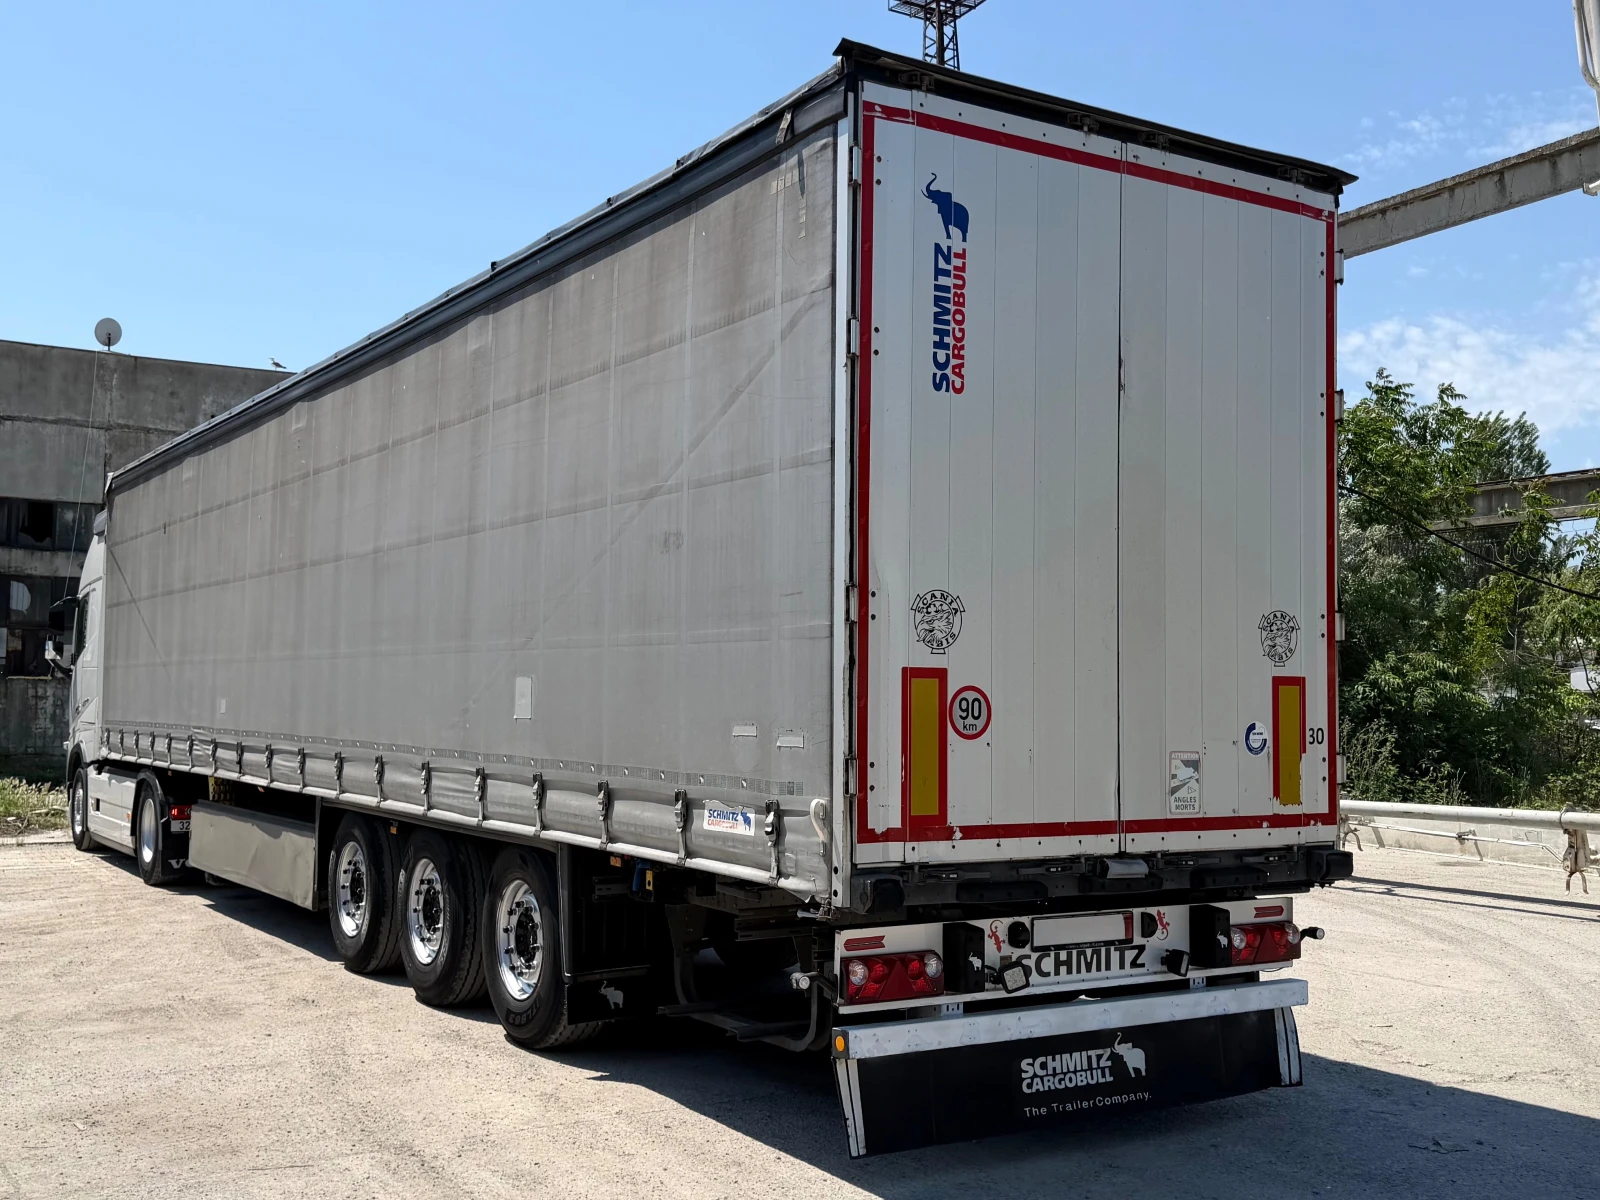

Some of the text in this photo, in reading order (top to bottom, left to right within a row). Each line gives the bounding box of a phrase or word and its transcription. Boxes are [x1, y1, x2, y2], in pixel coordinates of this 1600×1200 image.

[932, 242, 952, 393] SCHMITZ
[951, 248, 966, 394] CARGOBULL
[917, 592, 959, 617] SCANIA
[958, 696, 982, 721] 90
[962, 721, 977, 731] km
[1308, 727, 1325, 745] 30
[708, 808, 739, 822] SCHMITZ
[1020, 1047, 1112, 1078] SCHMITZ
[1021, 1067, 1114, 1094] CARGOBULL
[1023, 1106, 1048, 1118] The
